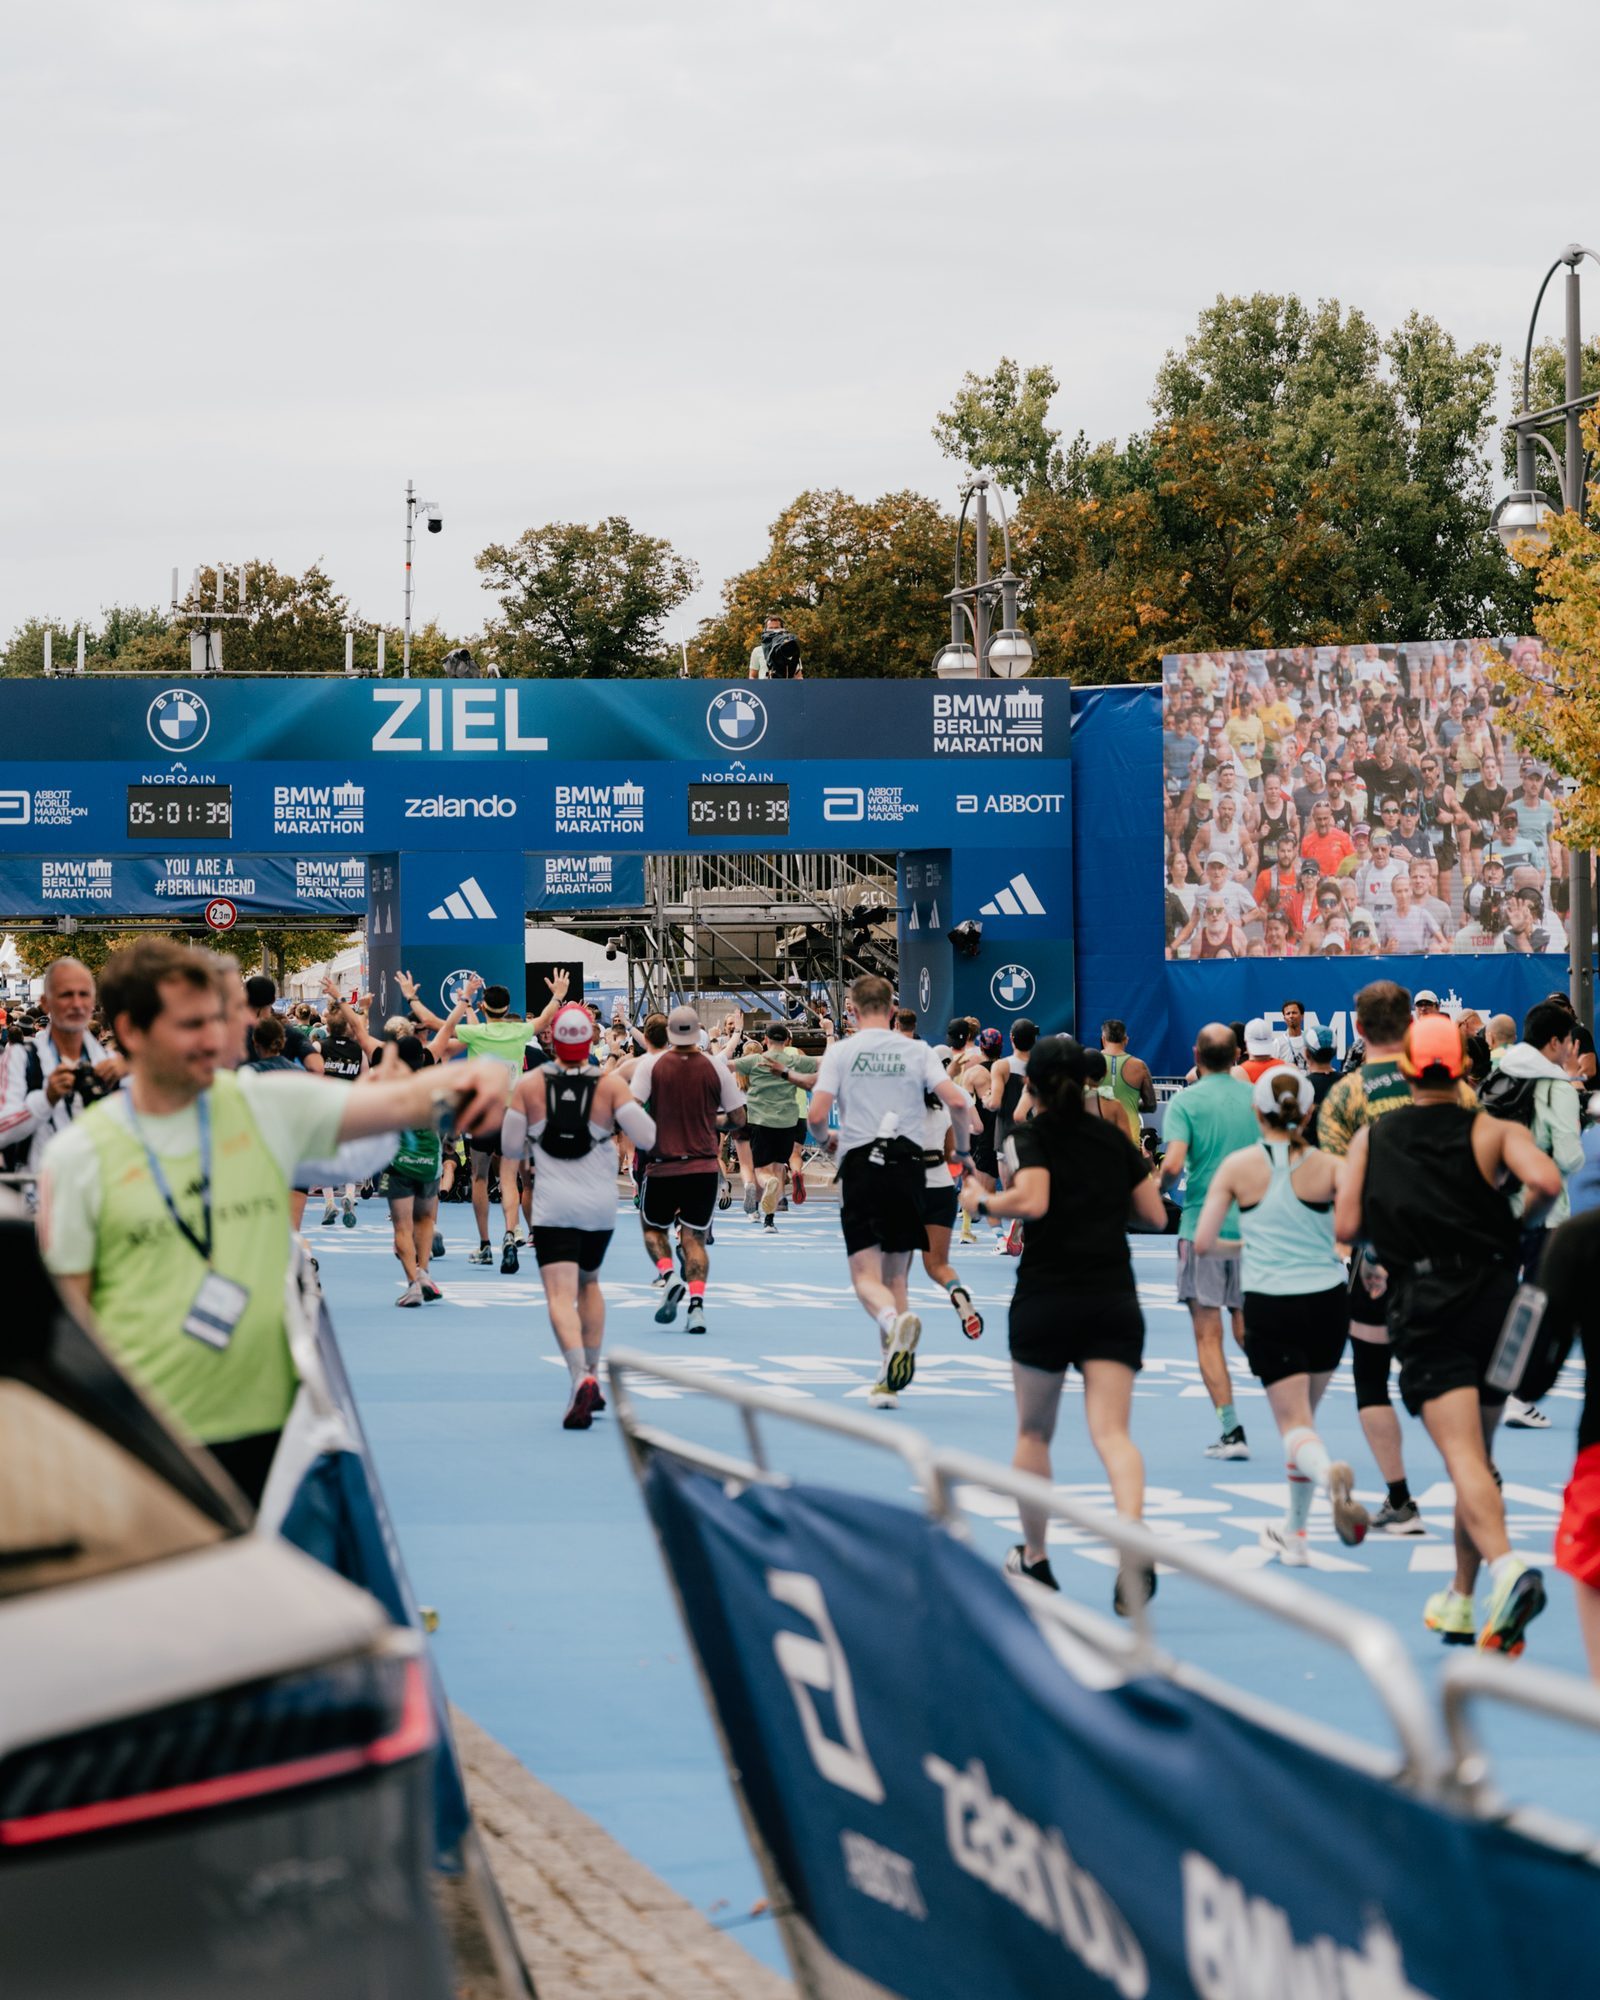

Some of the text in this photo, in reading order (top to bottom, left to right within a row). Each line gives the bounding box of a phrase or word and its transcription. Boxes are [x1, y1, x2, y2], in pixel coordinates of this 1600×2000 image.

[155, 692, 201, 710] BMW
[715, 692, 759, 709] BMW
[933, 694, 1002, 717] BMW
[372, 688, 549, 751] ZIEL
[933, 719, 1003, 734] BERLIN
[933, 737, 1043, 752] MARATHON
[142, 775, 216, 784] NORQAIN
[702, 773, 773, 783] NORQAIN
[34, 790, 72, 799] ABBOTT
[274, 787, 330, 804] BMW
[556, 786, 611, 804] BMW
[868, 788, 903, 796] ABBOTT
[34, 799, 69, 807] WORLD
[405, 795, 517, 817] zalando
[868, 804, 919, 812] MARATHON
[984, 795, 1064, 813] ABBOTT
[34, 808, 88, 816] MARATHON
[130, 802, 229, 824] 05:01:39
[274, 807, 331, 819] BERLIN
[556, 806, 611, 818] BERLIN
[692, 800, 788, 821] 05:01:39
[34, 816, 72, 824] MAJORS
[868, 813, 904, 821] MAJORS
[274, 821, 364, 833] MARATHON
[556, 820, 644, 832] MARATHON
[42, 862, 86, 876] BMW
[165, 859, 234, 875] YOU ARE A
[296, 862, 338, 876] BMW
[545, 858, 587, 872] BMW
[42, 878, 87, 887] BERLIN
[296, 878, 340, 887] BERLIN
[545, 873, 588, 883] BERLIN
[155, 879, 255, 895] #BERLINLEGEND
[545, 883, 612, 894] MARATHON
[42, 889, 112, 898] MARATHON
[296, 889, 365, 898] MARATHON
[997, 967, 1030, 979] BMW
[324, 1061, 359, 1075] BERLIN
